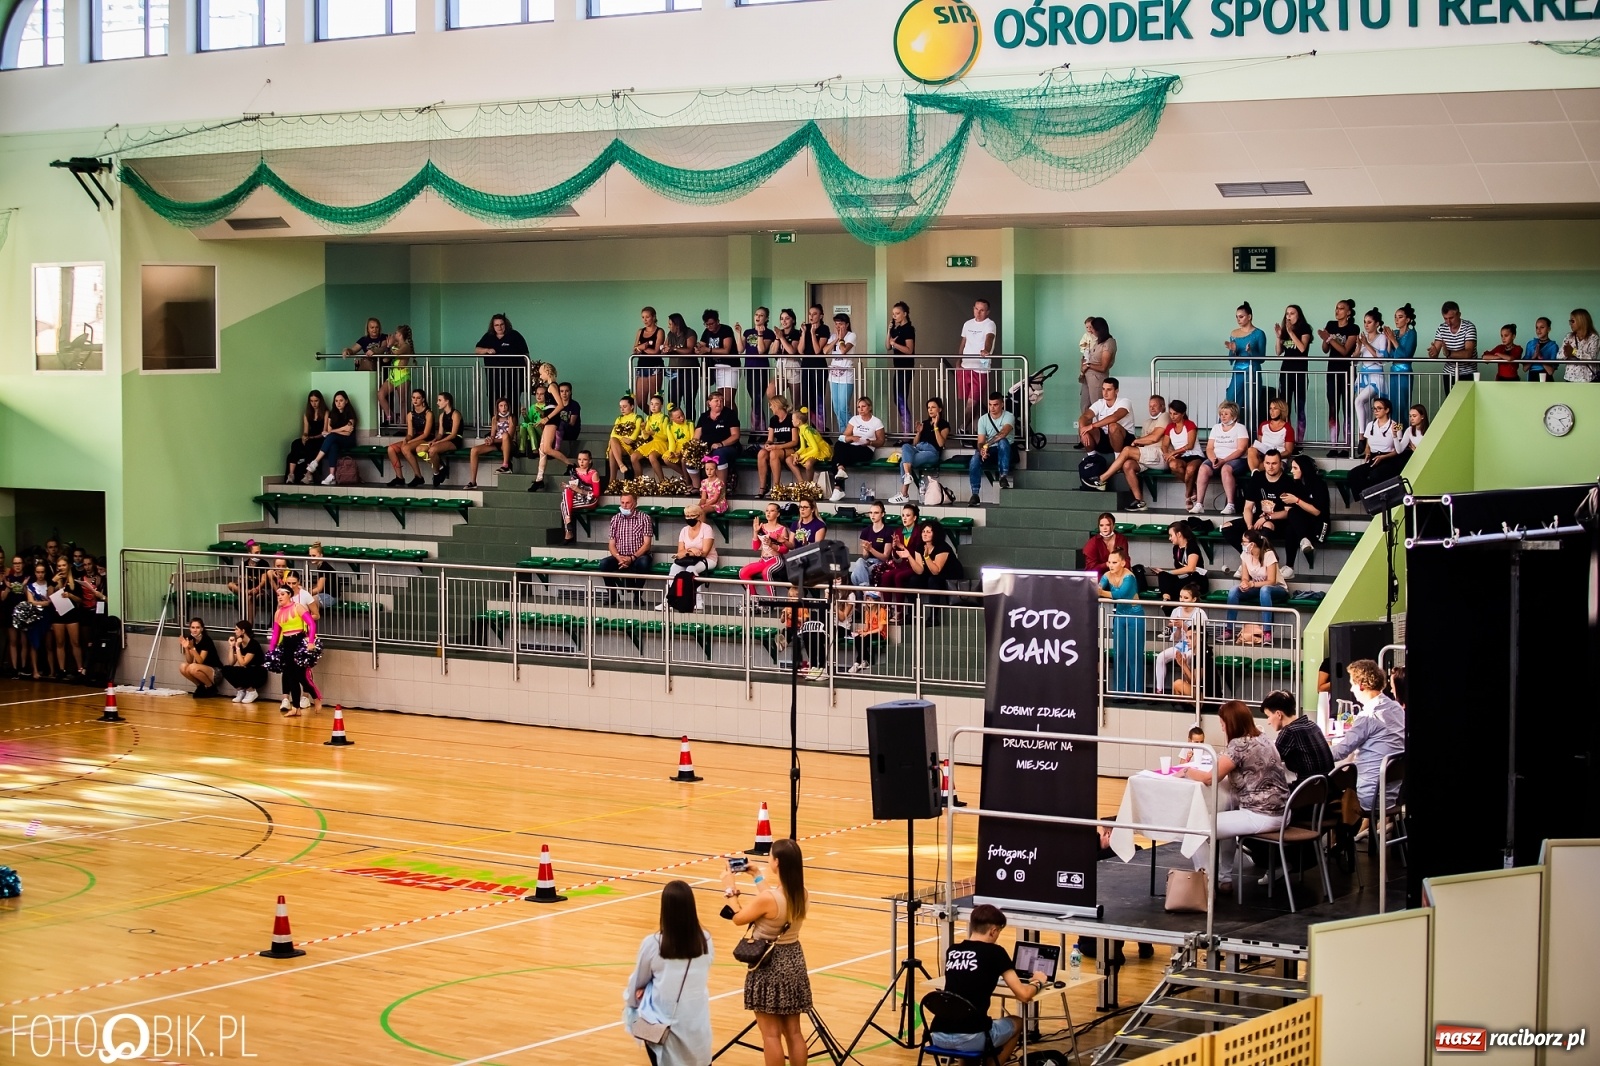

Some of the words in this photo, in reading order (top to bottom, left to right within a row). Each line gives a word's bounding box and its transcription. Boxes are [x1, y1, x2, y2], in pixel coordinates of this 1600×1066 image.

[994, 0, 1194, 49] OŚRODEK
[1210, 0, 1391, 38] SPORTU
[1250, 255, 1267, 270] E
[1008, 606, 1071, 630] FOTO
[999, 637, 1079, 666] GANS
[1000, 705, 1035, 717] ROBIMY
[1002, 737, 1059, 751] DRUKUJEMY
[1060, 741, 1074, 752] NA
[1016, 759, 1059, 771] MIEJSCU
[987, 843, 1038, 865] fotogans.pl
[948, 950, 977, 960] FOTO
